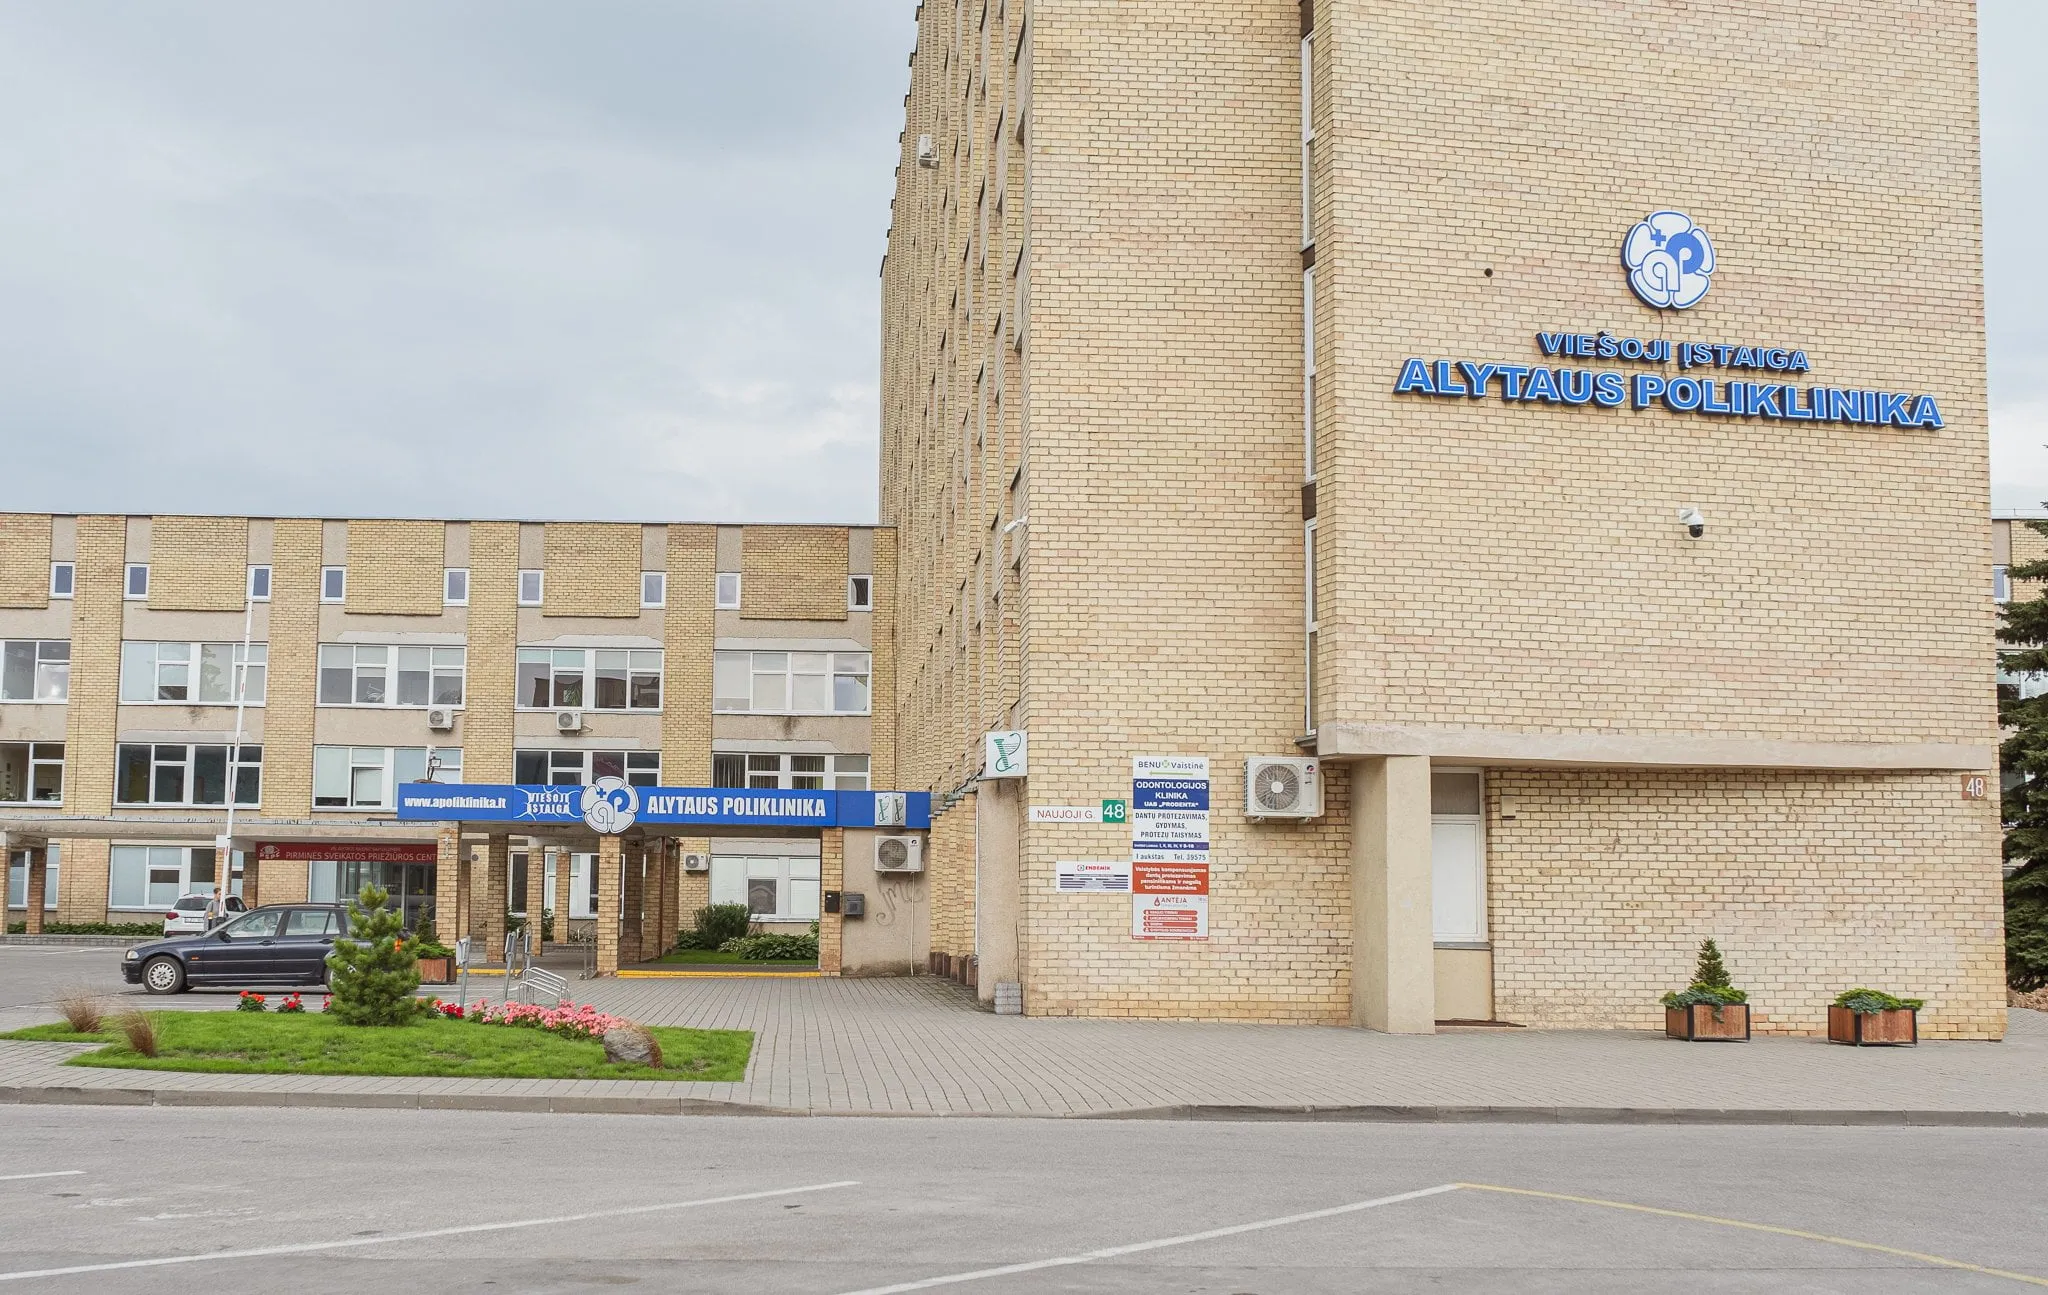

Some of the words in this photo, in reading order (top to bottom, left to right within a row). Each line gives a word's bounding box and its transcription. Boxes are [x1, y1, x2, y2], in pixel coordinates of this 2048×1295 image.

[1538, 331, 1672, 362] VIEŠOJI
[1680, 342, 1811, 371] ĮSTAIGA
[1396, 357, 1626, 408] ALYTAUS
[1632, 373, 1947, 430] POLIKLINIKA
[1170, 761, 1204, 769] Vaistinė
[1136, 781, 1207, 790] ODONTOLOGIJOS
[1966, 777, 1984, 797] 48
[1155, 792, 1188, 800] KLINIKA
[404, 797, 507, 809] www.apoliklinika.lt
[647, 795, 719, 815] ALYTAUS
[722, 797, 827, 817] POLIKLINIKA
[1037, 809, 1082, 820] NAUJOJI
[1084, 810, 1096, 820] G.
[1103, 804, 1125, 818] 48
[1135, 812, 1156, 820] DANTŲ
[1158, 813, 1208, 821] PROTEZAVIMAS,
[324, 852, 366, 861] SVEIKATOS
[368, 852, 414, 862] PRIEŽIŪROS
